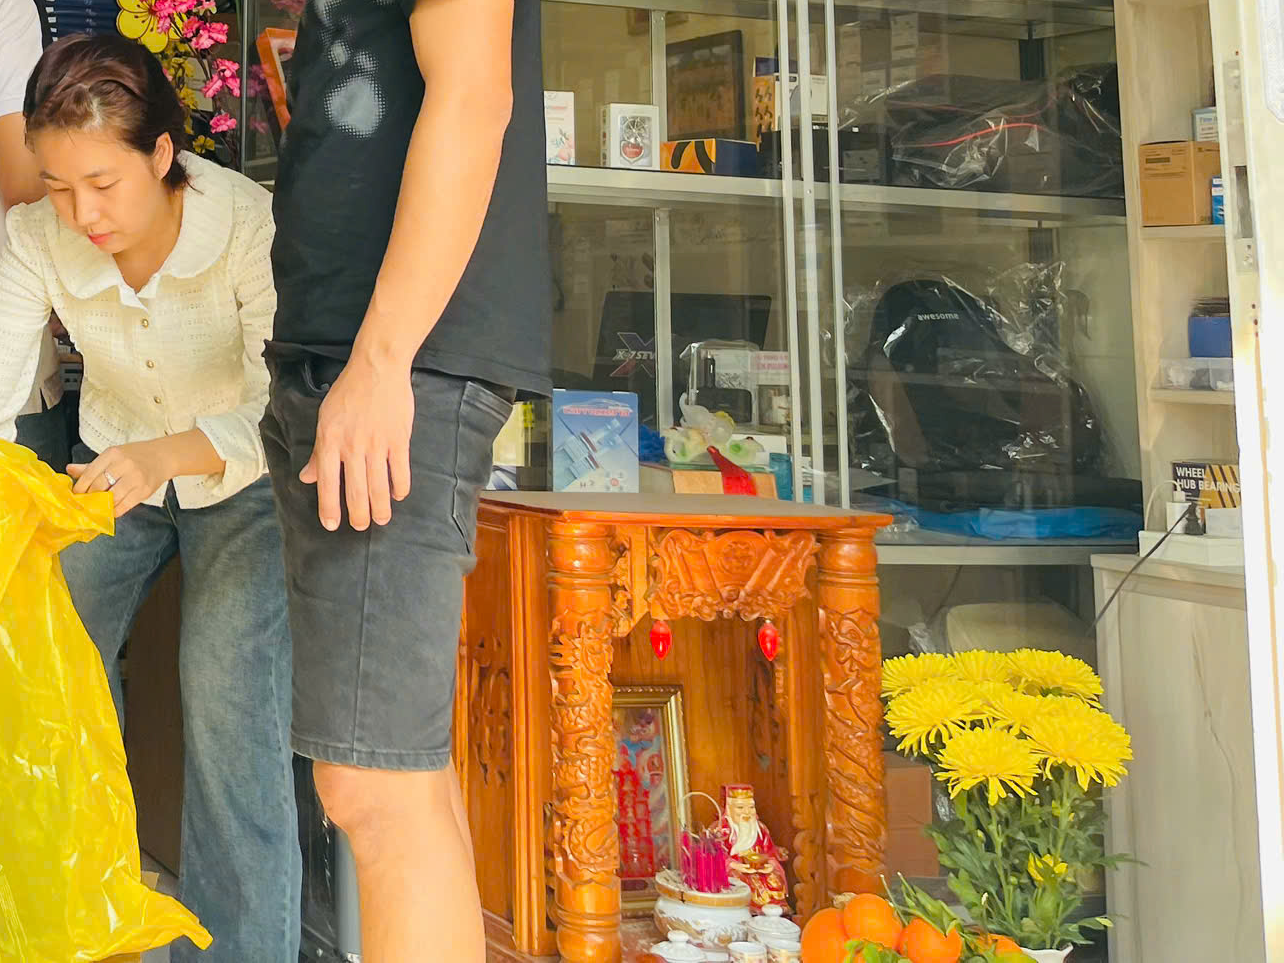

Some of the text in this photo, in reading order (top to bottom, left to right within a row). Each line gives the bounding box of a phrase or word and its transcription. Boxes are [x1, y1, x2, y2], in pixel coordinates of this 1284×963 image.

[917, 310, 960, 321] awesome
[1175, 466, 1208, 479] WHEEL
[1176, 479, 1241, 494] HUB BEARING
